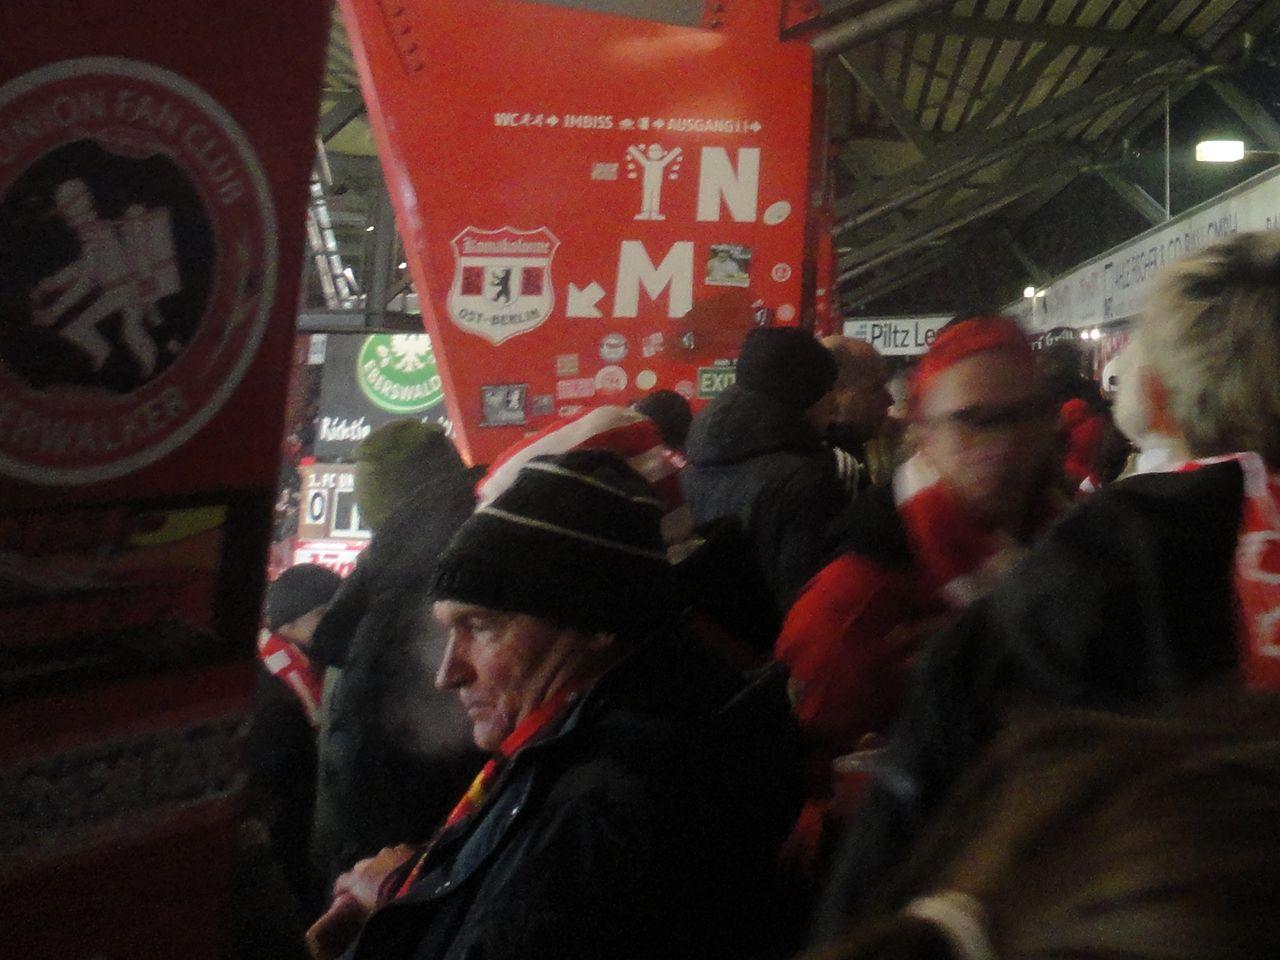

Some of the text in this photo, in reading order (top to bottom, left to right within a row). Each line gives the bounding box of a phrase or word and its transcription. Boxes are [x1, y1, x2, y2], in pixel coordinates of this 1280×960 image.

[564, 115, 613, 129] IMBISS
[667, 118, 734, 133] AUSGANG
[114, 88, 184, 136] FAN
[182, 122, 247, 207] CLUB
[458, 307, 540, 326] OST-BERLIN
[871, 322, 910, 348] Piltz
